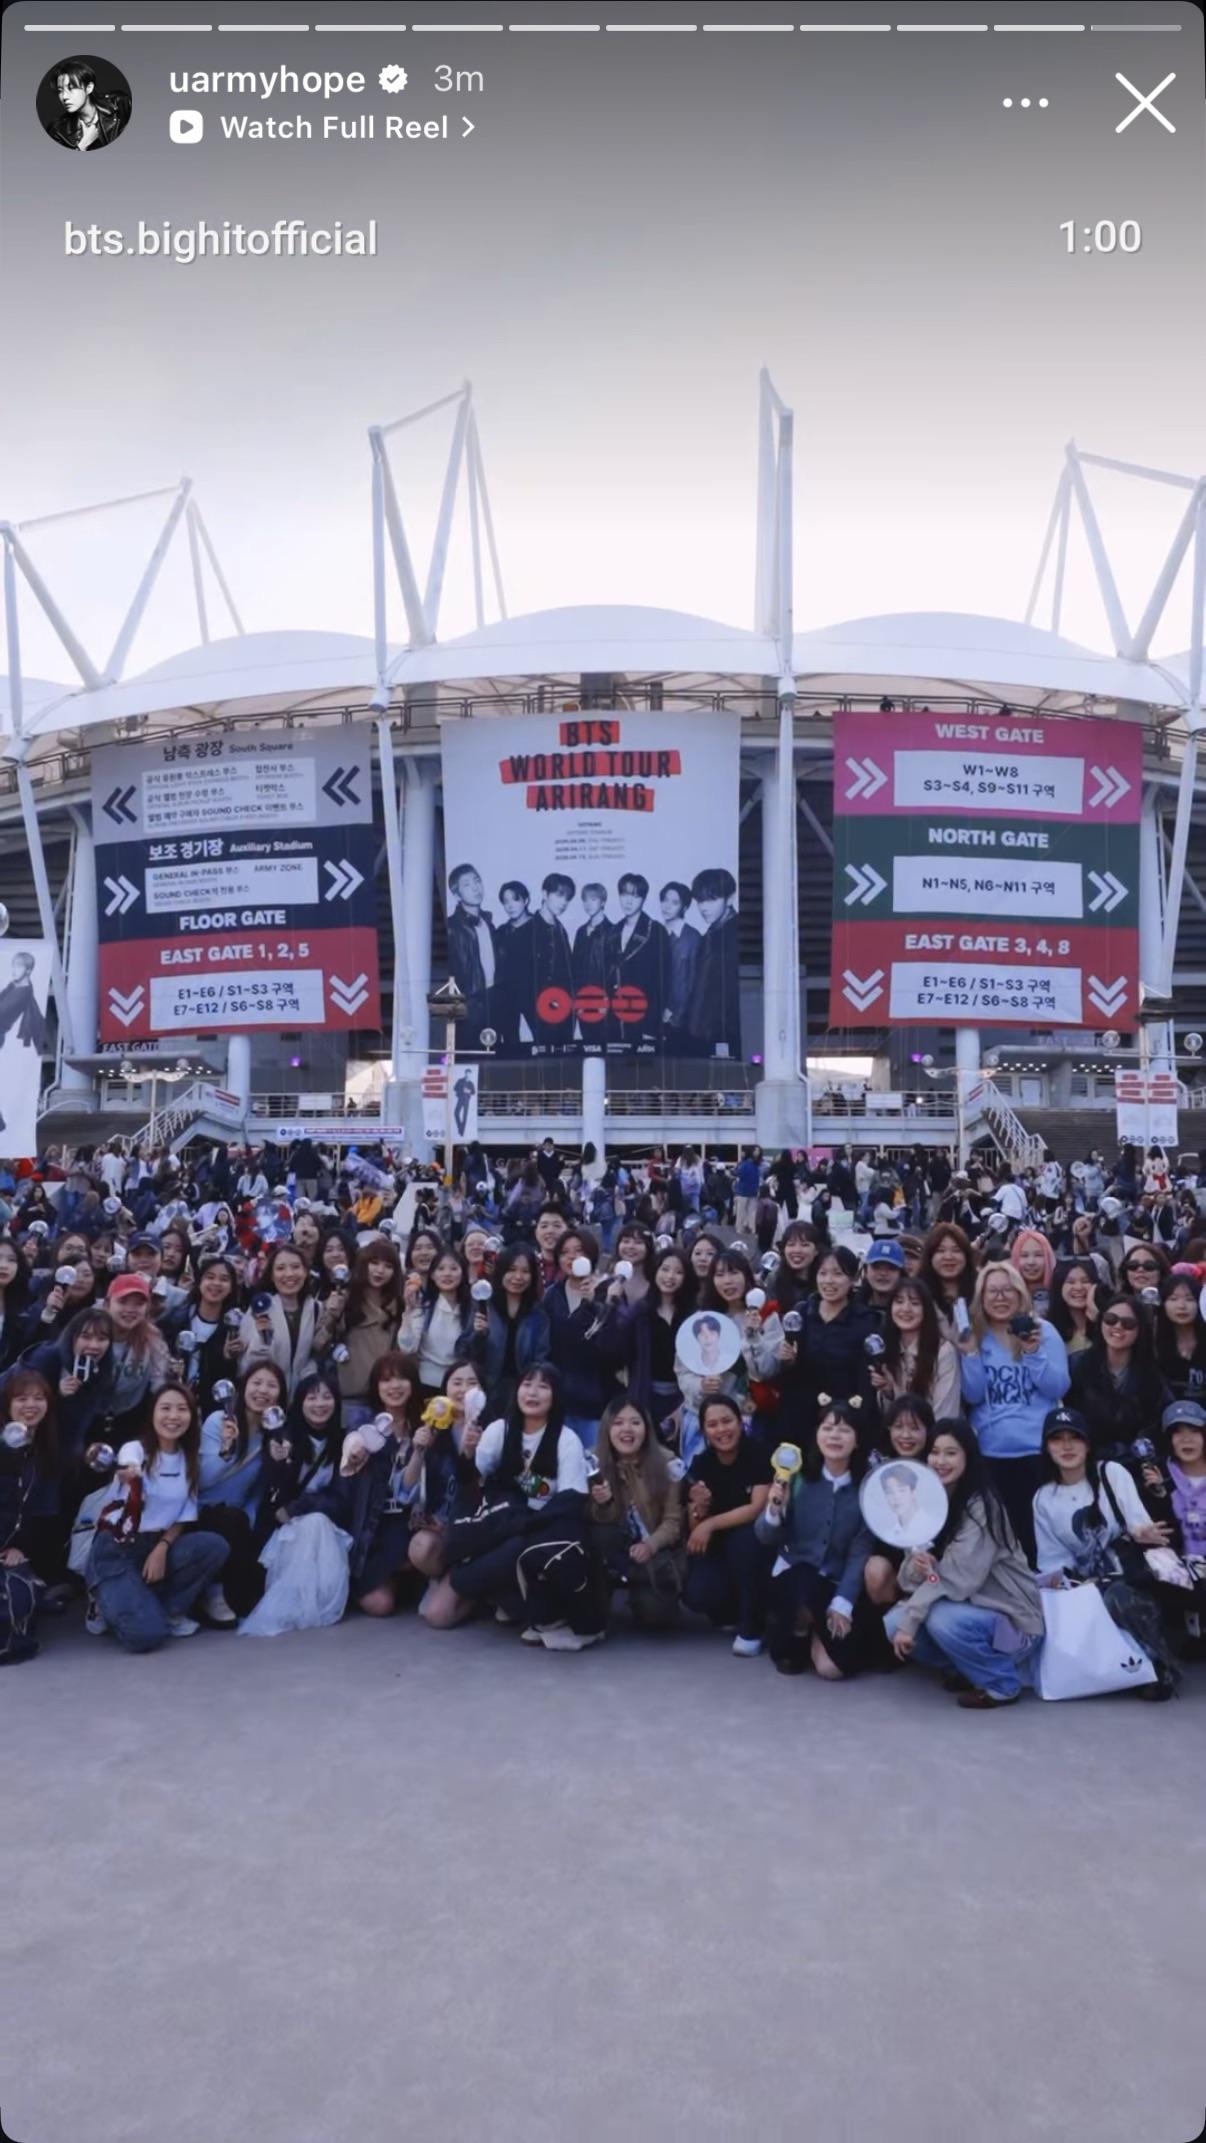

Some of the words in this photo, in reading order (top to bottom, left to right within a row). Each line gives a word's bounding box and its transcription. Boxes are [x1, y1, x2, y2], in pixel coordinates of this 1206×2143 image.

[566, 720, 612, 747] BTS
[935, 723, 990, 741] WEST
[995, 726, 1045, 743] GATE
[163, 741, 191, 762] 남측
[194, 739, 224, 759] 광장
[228, 743, 259, 755] South
[260, 741, 294, 754] Square
[509, 753, 596, 782] WORLD
[608, 750, 671, 778] TOUR
[963, 764, 1019, 778] W1~W8
[536, 783, 646, 811] ARIRANG
[923, 779, 974, 796] S3~S4,
[978, 781, 1029, 795] S9~S11
[1032, 784, 1056, 798] 구역
[201, 806, 232, 817] SOUND
[234, 804, 263, 814] CHECK
[928, 828, 996, 846] NORTH
[1001, 831, 1049, 848] GATE
[148, 841, 178, 861] 보조
[180, 837, 224, 857] 경기장
[229, 841, 272, 855] Auxiliary
[273, 839, 313, 852] Stadium
[154, 890, 182, 900] SOUND
[922, 878, 971, 893] N1~N5,
[975, 879, 1027, 893] N6~N11
[1030, 880, 1055, 895] 구역
[179, 912, 236, 930] FLOOR
[240, 910, 287, 927] GATE
[160, 948, 203, 965] EAST
[208, 945, 253, 962] GATE
[258, 944, 274, 962] 1,
[277, 944, 295, 961] 2,
[298, 943, 310, 958] 5
[905, 934, 954, 950] EAST
[959, 936, 1010, 953] GATE
[1015, 938, 1032, 956] 3,
[1036, 939, 1053, 956] 4,
[1058, 940, 1070, 954] 8
[178, 986, 216, 1000] E1~E6
[227, 984, 268, 998] S1~S3
[271, 982, 294, 996] 구역
[923, 976, 967, 989] E1~E6
[979, 977, 1024, 991] S1~S3
[1027, 979, 1051, 993] 구역
[173, 1003, 219, 1016] E7~E12
[230, 1000, 274, 1014] S6~S8
[277, 998, 300, 1012] 구역
[917, 993, 968, 1006] E7~E12
[982, 995, 1029, 1008] S6~S8
[1033, 996, 1056, 1010] 구역
